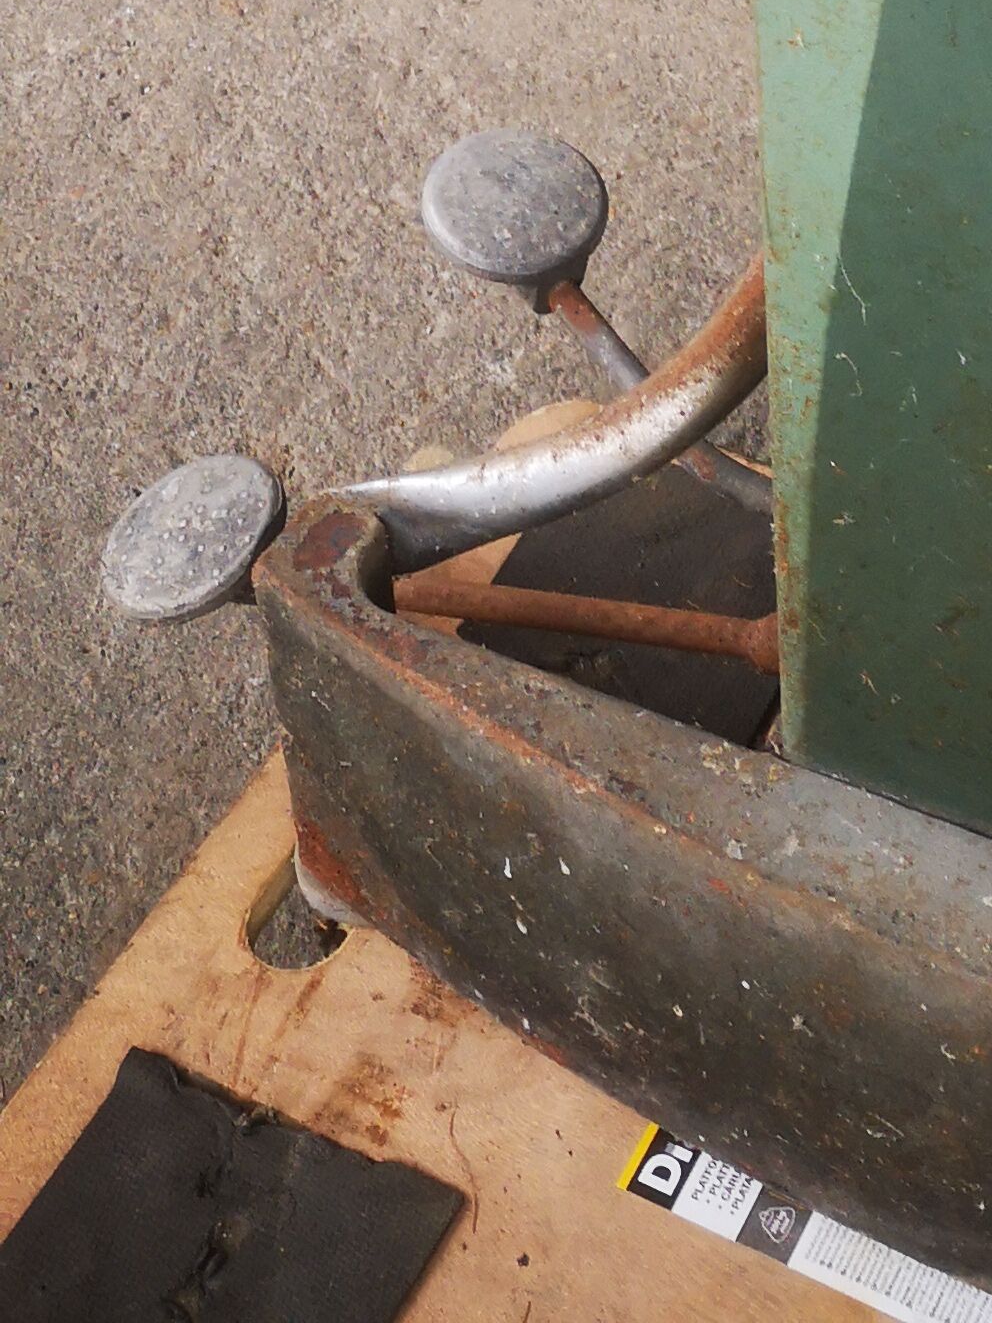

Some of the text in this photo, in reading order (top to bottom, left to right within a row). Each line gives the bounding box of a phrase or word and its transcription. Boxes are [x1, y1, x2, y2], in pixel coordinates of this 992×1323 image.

[637, 1141, 695, 1196] Di
[691, 1159, 717, 1202] PLATFO
[708, 1163, 731, 1197] PLATT
[731, 1177, 754, 1211] PLATA
